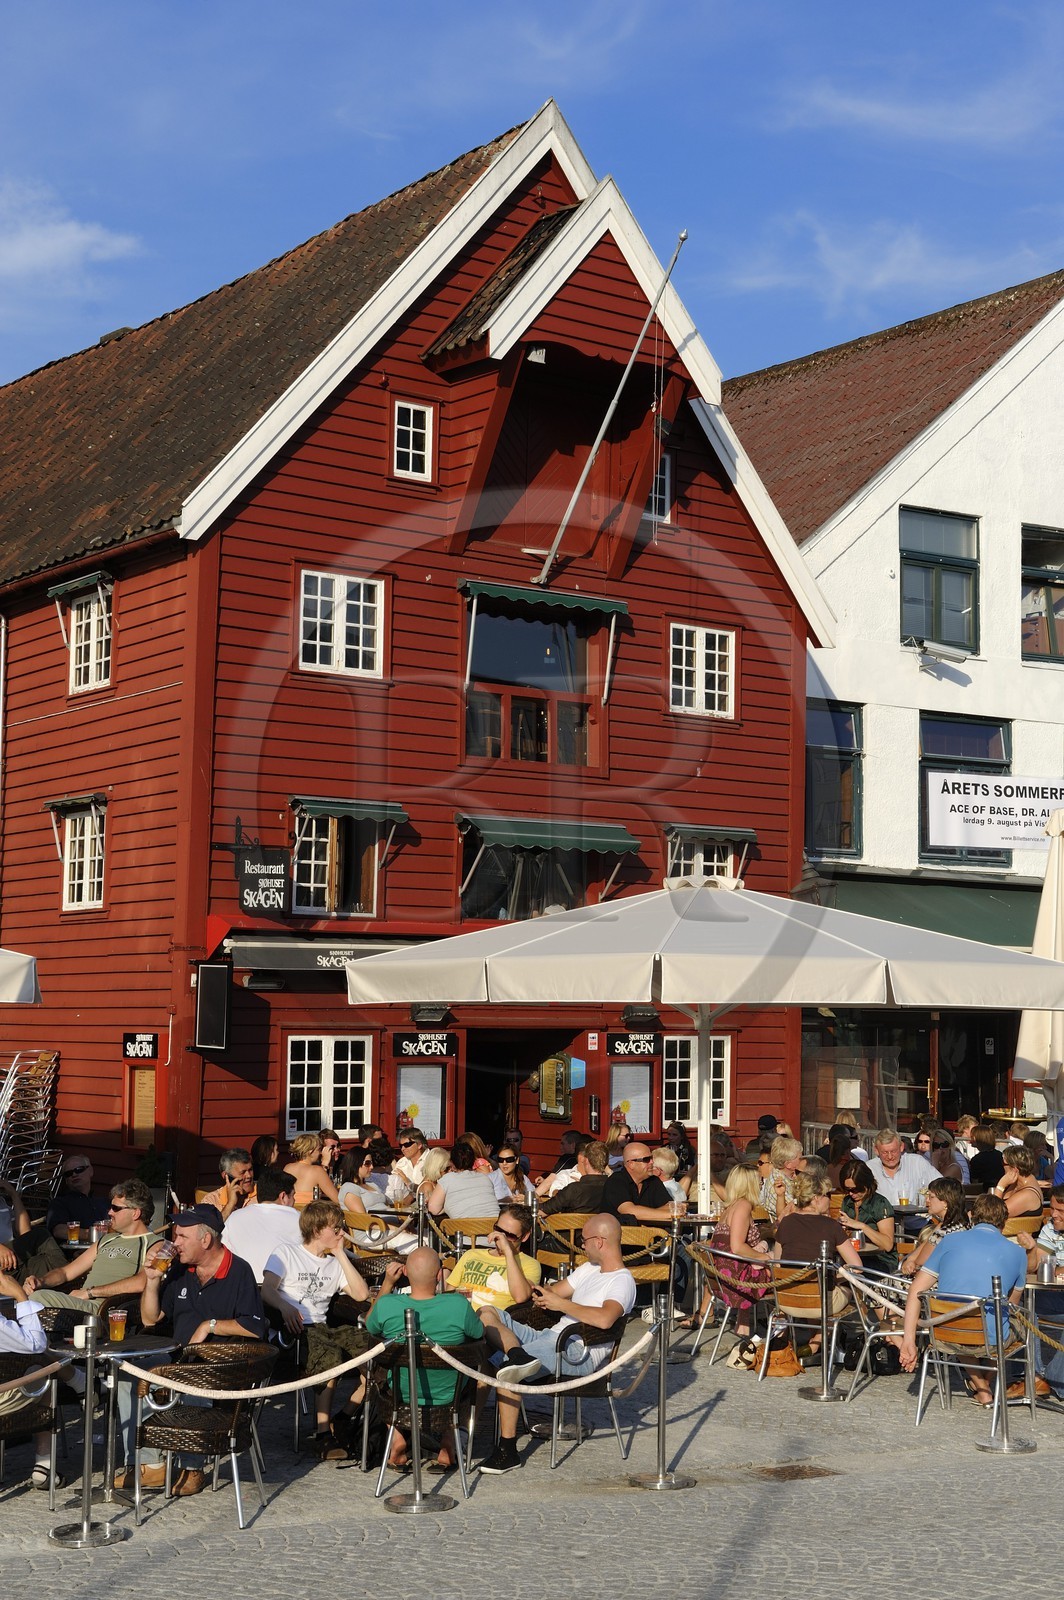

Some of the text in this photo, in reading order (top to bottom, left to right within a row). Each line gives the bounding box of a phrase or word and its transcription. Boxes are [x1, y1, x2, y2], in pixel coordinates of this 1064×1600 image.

[940, 779, 990, 796] ÅRETS
[949, 804, 970, 814] ACE
[972, 805, 986, 814] OF
[989, 806, 1018, 818] BASE,
[1021, 807, 1038, 817] DR.
[962, 816, 985, 826] lørdag
[987, 817, 995, 825] 9.
[996, 819, 1021, 828] august
[1023, 819, 1033, 828] på
[244, 859, 285, 875] Restaurant
[258, 878, 285, 888] SJØHUSET
[243, 888, 285, 909] SKAGEN
[402, 1041, 448, 1056] SKAGEN
[614, 1041, 655, 1055] SKAGEN
